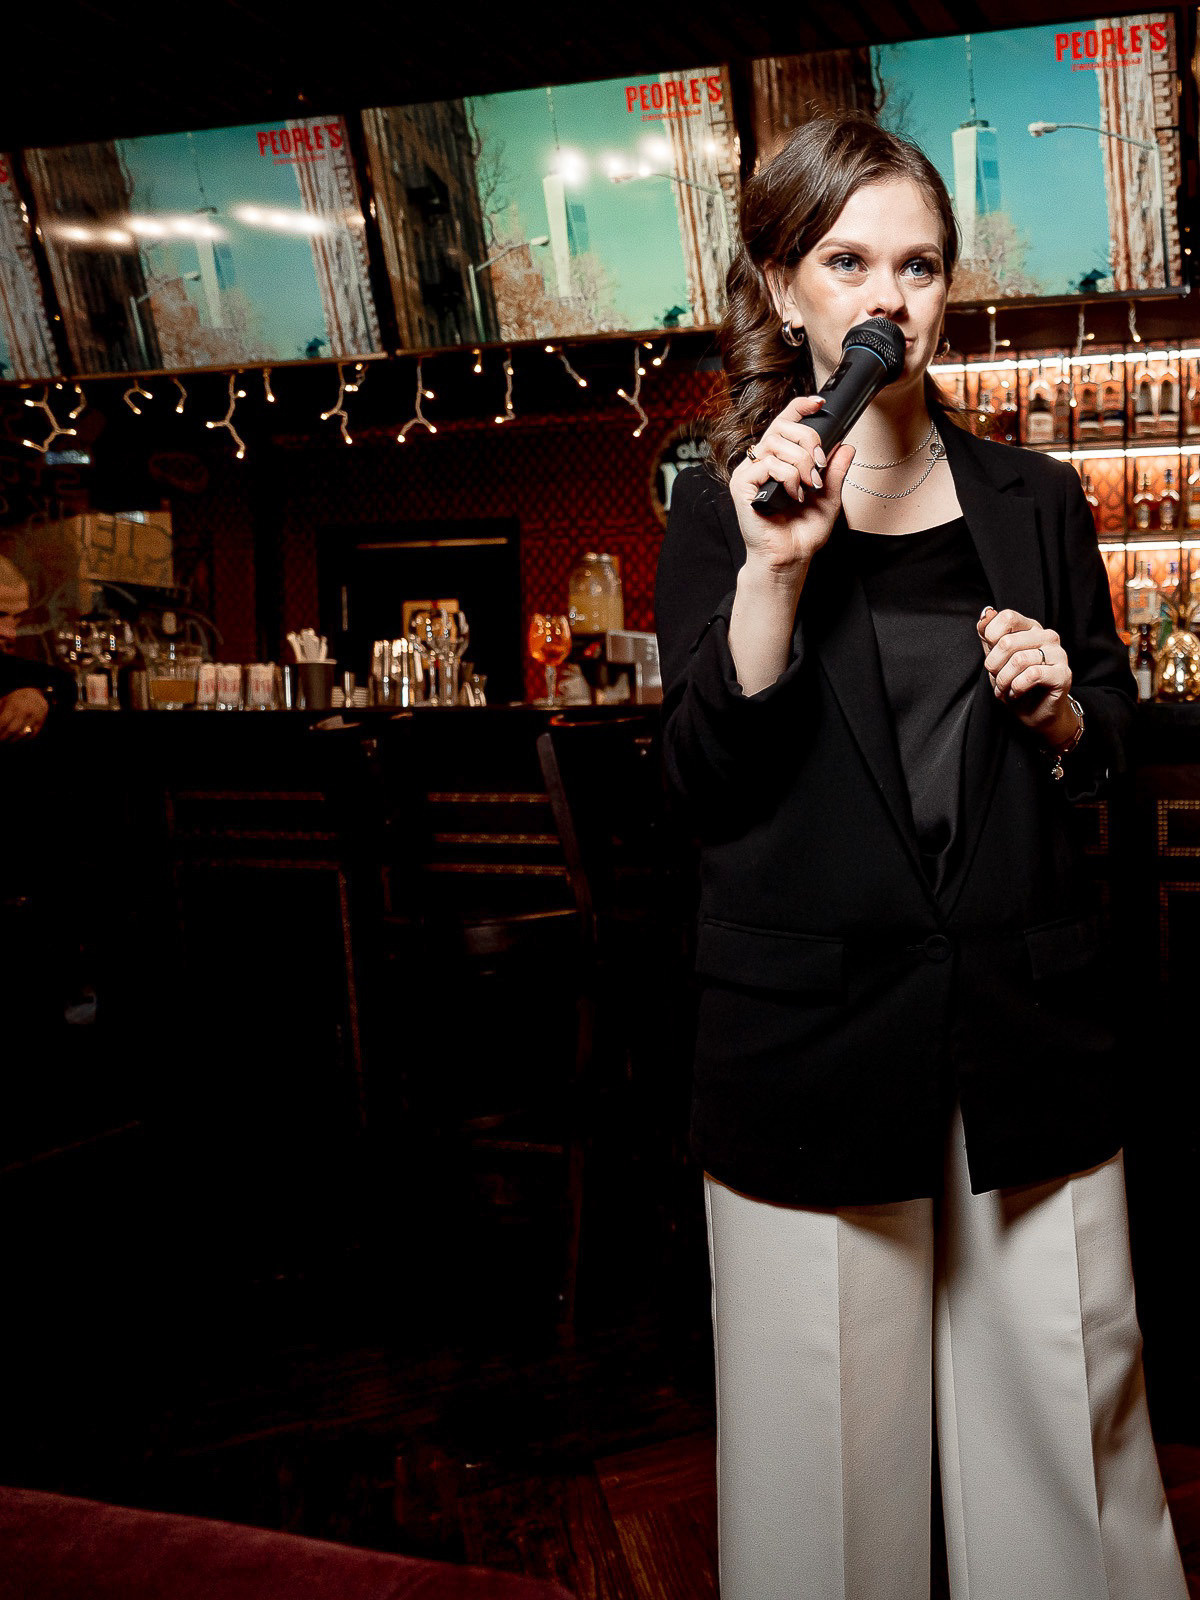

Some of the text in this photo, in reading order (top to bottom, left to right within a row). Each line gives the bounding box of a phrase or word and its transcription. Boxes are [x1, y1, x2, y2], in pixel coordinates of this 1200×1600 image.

[1055, 21, 1168, 62] PEOPLE'S
[625, 76, 723, 113] PEOPLE'S
[257, 123, 343, 157] PEOPLE'S
